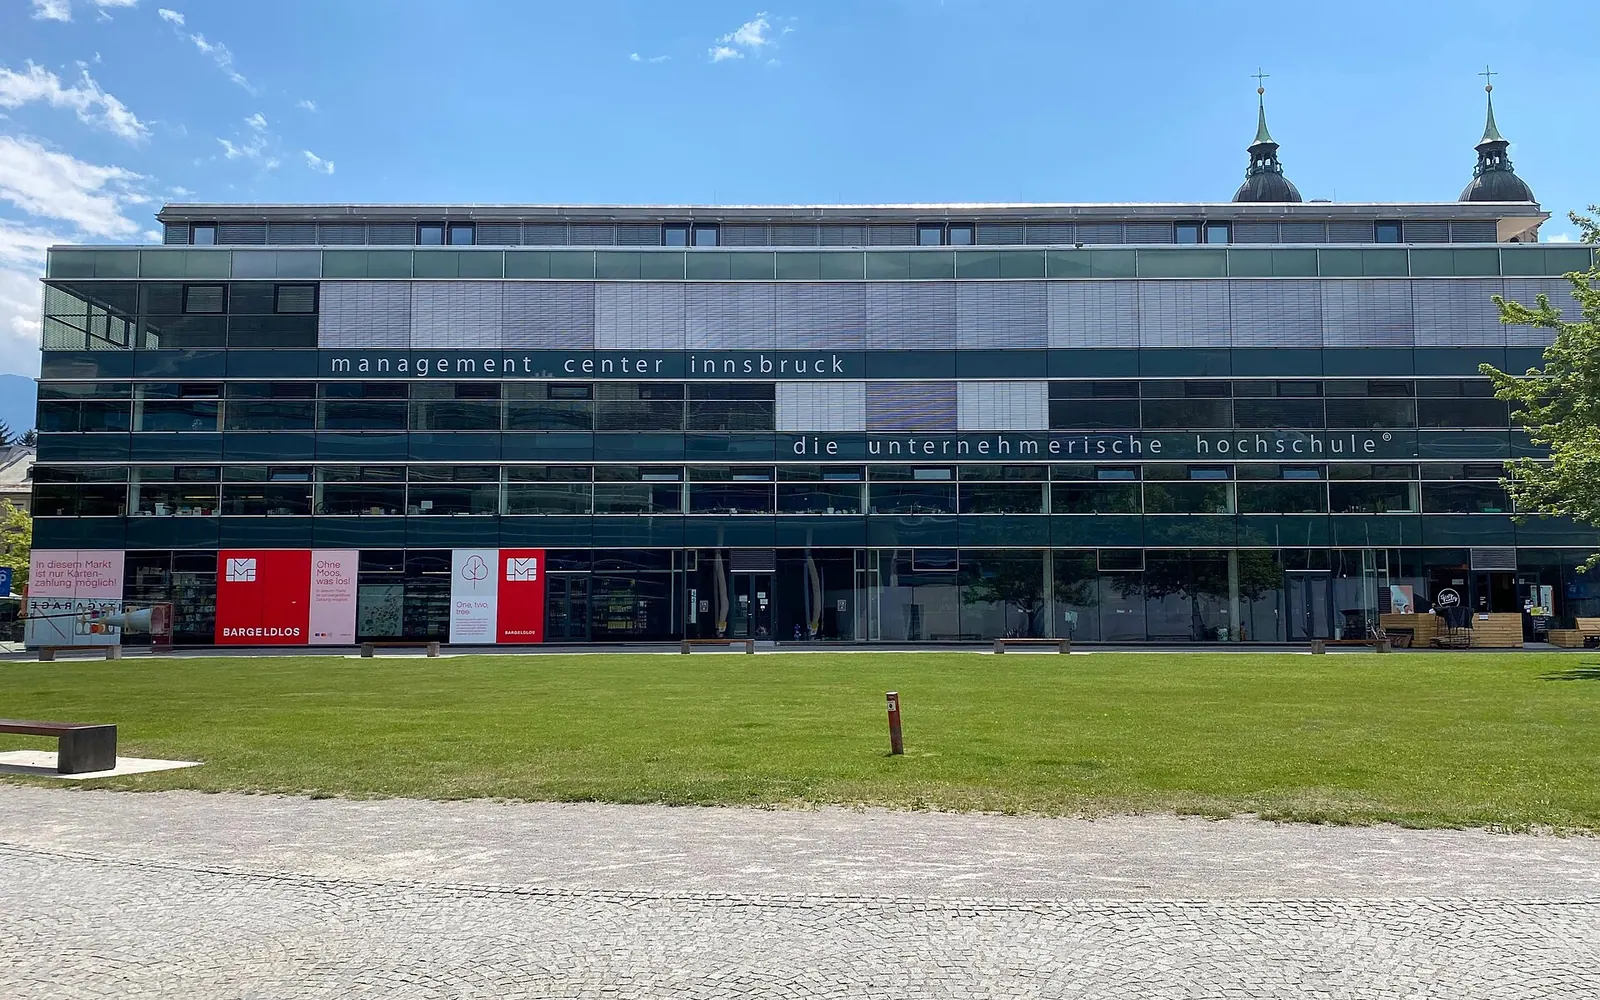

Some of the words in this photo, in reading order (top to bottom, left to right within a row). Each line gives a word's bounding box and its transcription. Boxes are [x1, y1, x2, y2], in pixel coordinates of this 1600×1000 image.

[331, 356, 532, 377] management
[563, 356, 663, 373] center
[691, 354, 844, 373] innsbruck
[793, 436, 838, 454] die
[868, 435, 1163, 454] unternehmerische
[35, 560, 45, 569] In
[47, 560, 82, 569] diesem
[85, 560, 112, 569] Markt
[316, 560, 341, 569] Ohne
[35, 569, 46, 578] ist
[67, 569, 103, 578] Karten-
[316, 569, 342, 578] Moos,
[34, 579, 72, 589] zahlung
[75, 578, 117, 589] möglich!
[335, 577, 351, 585] los!
[456, 601, 473, 609] One,
[223, 627, 301, 637] BARGELDLOS
